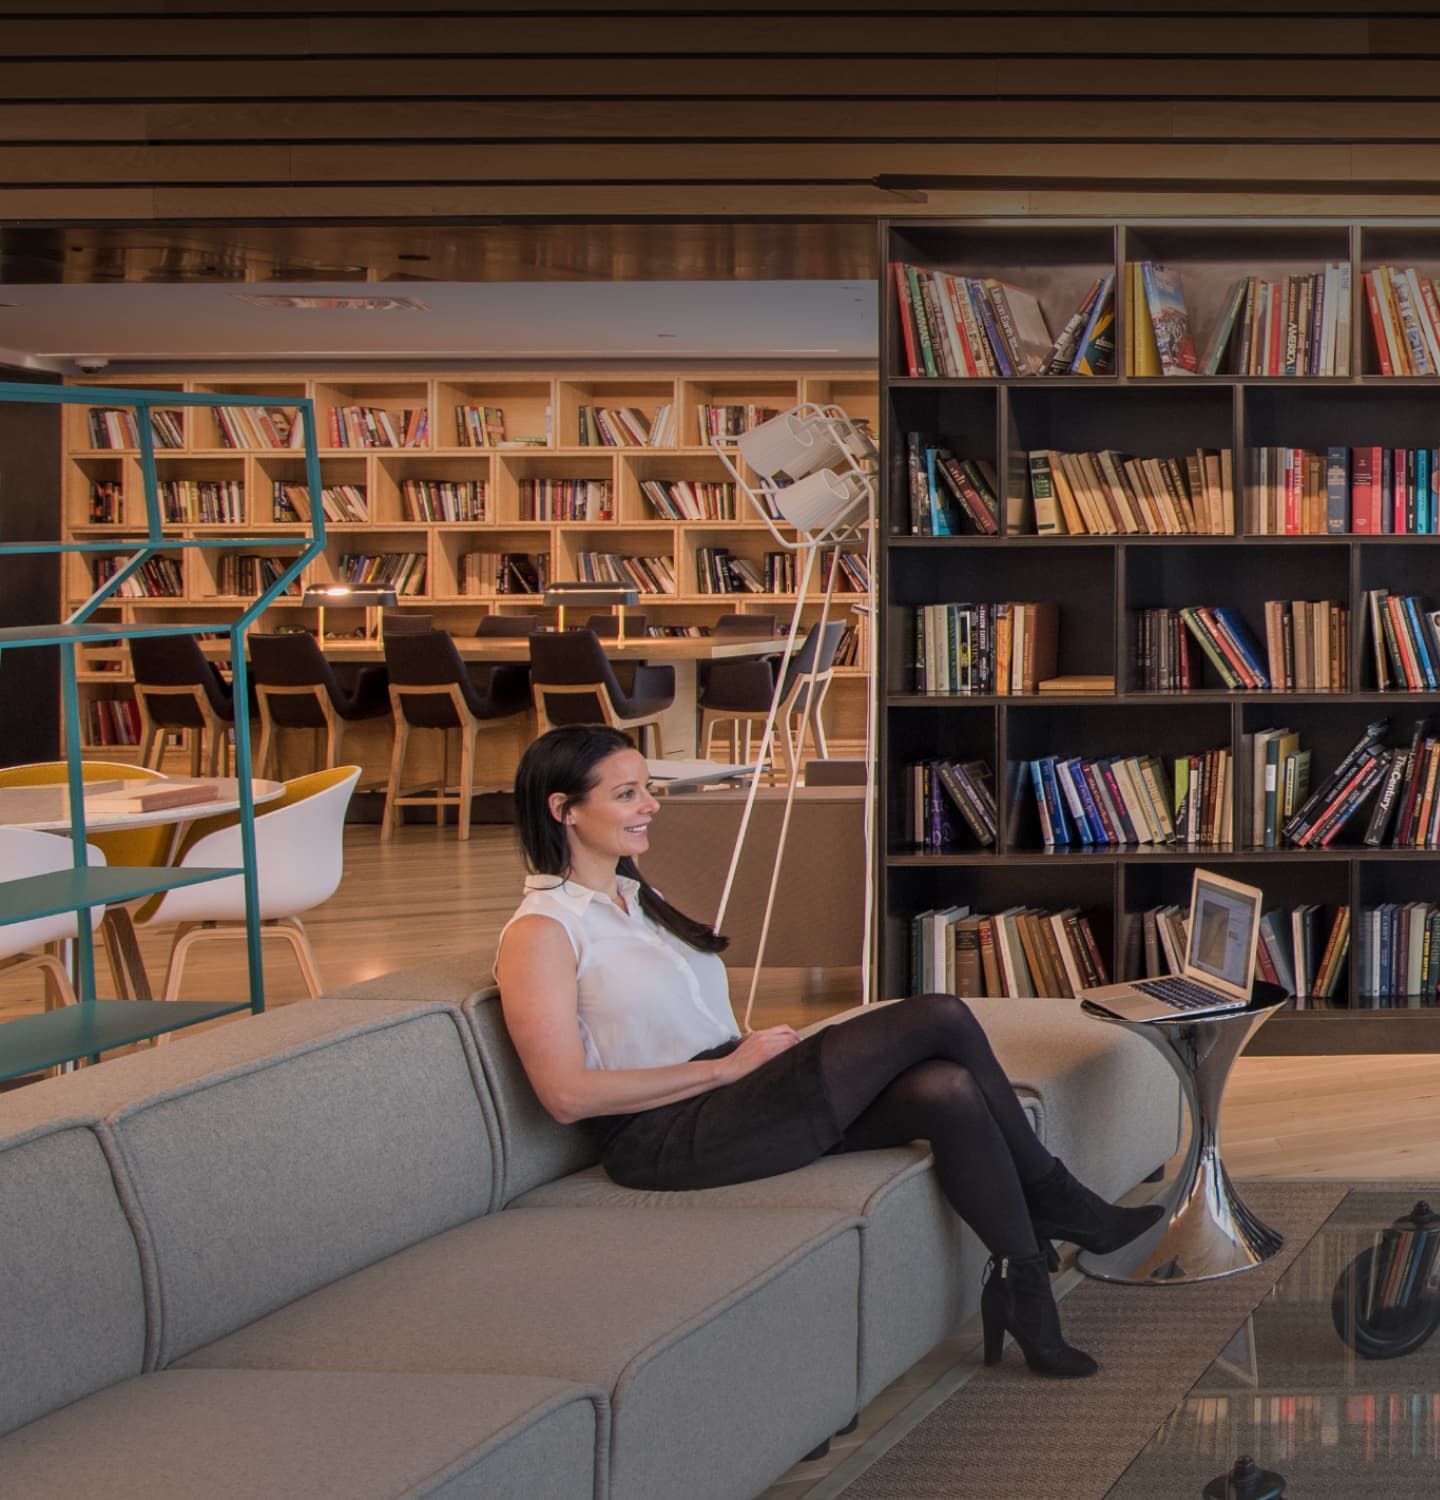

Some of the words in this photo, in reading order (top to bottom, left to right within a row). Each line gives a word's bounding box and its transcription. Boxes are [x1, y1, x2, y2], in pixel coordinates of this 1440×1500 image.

[911, 294, 931, 346] MAMMALS
[996, 303, 1006, 315] on
[1000, 314, 1014, 337] Earth
[1287, 321, 1297, 363] AMERICA
[1377, 769, 1401, 810] Century
